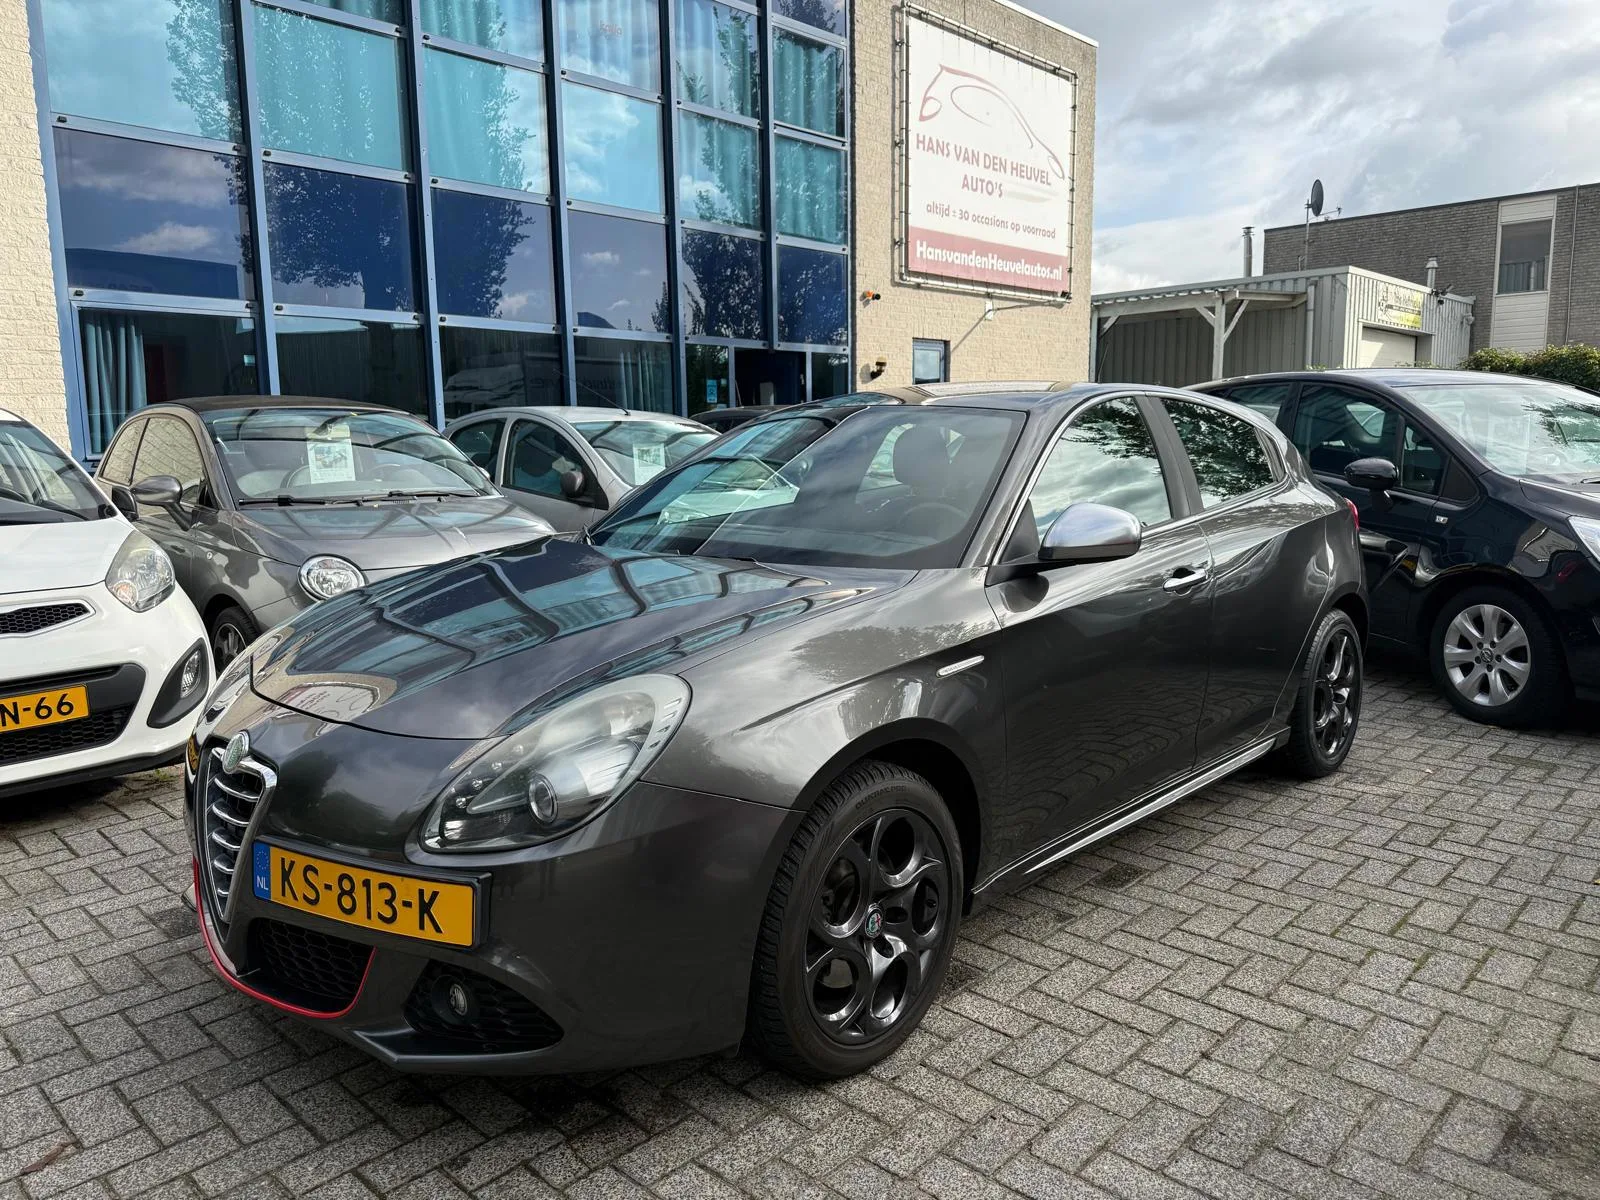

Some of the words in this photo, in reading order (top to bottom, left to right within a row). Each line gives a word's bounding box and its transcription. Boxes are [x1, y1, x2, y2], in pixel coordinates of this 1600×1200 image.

[916, 133, 950, 158] HANS
[954, 144, 980, 167] VAN
[983, 153, 1007, 174] DEN
[1010, 161, 1052, 186] HEUVEL
[961, 174, 1003, 198] AUTO'S
[926, 201, 950, 218] altijd
[958, 209, 970, 221] 30
[971, 213, 1008, 229] occasions
[1010, 221, 1020, 233] op
[1022, 225, 1056, 239] voorraad
[916, 240, 1062, 281] HansvandenHeuvelautos.nl
[0, 693, 74, 727] N-66
[256, 876, 269, 891] NL
[280, 856, 444, 935] KS-813-K
